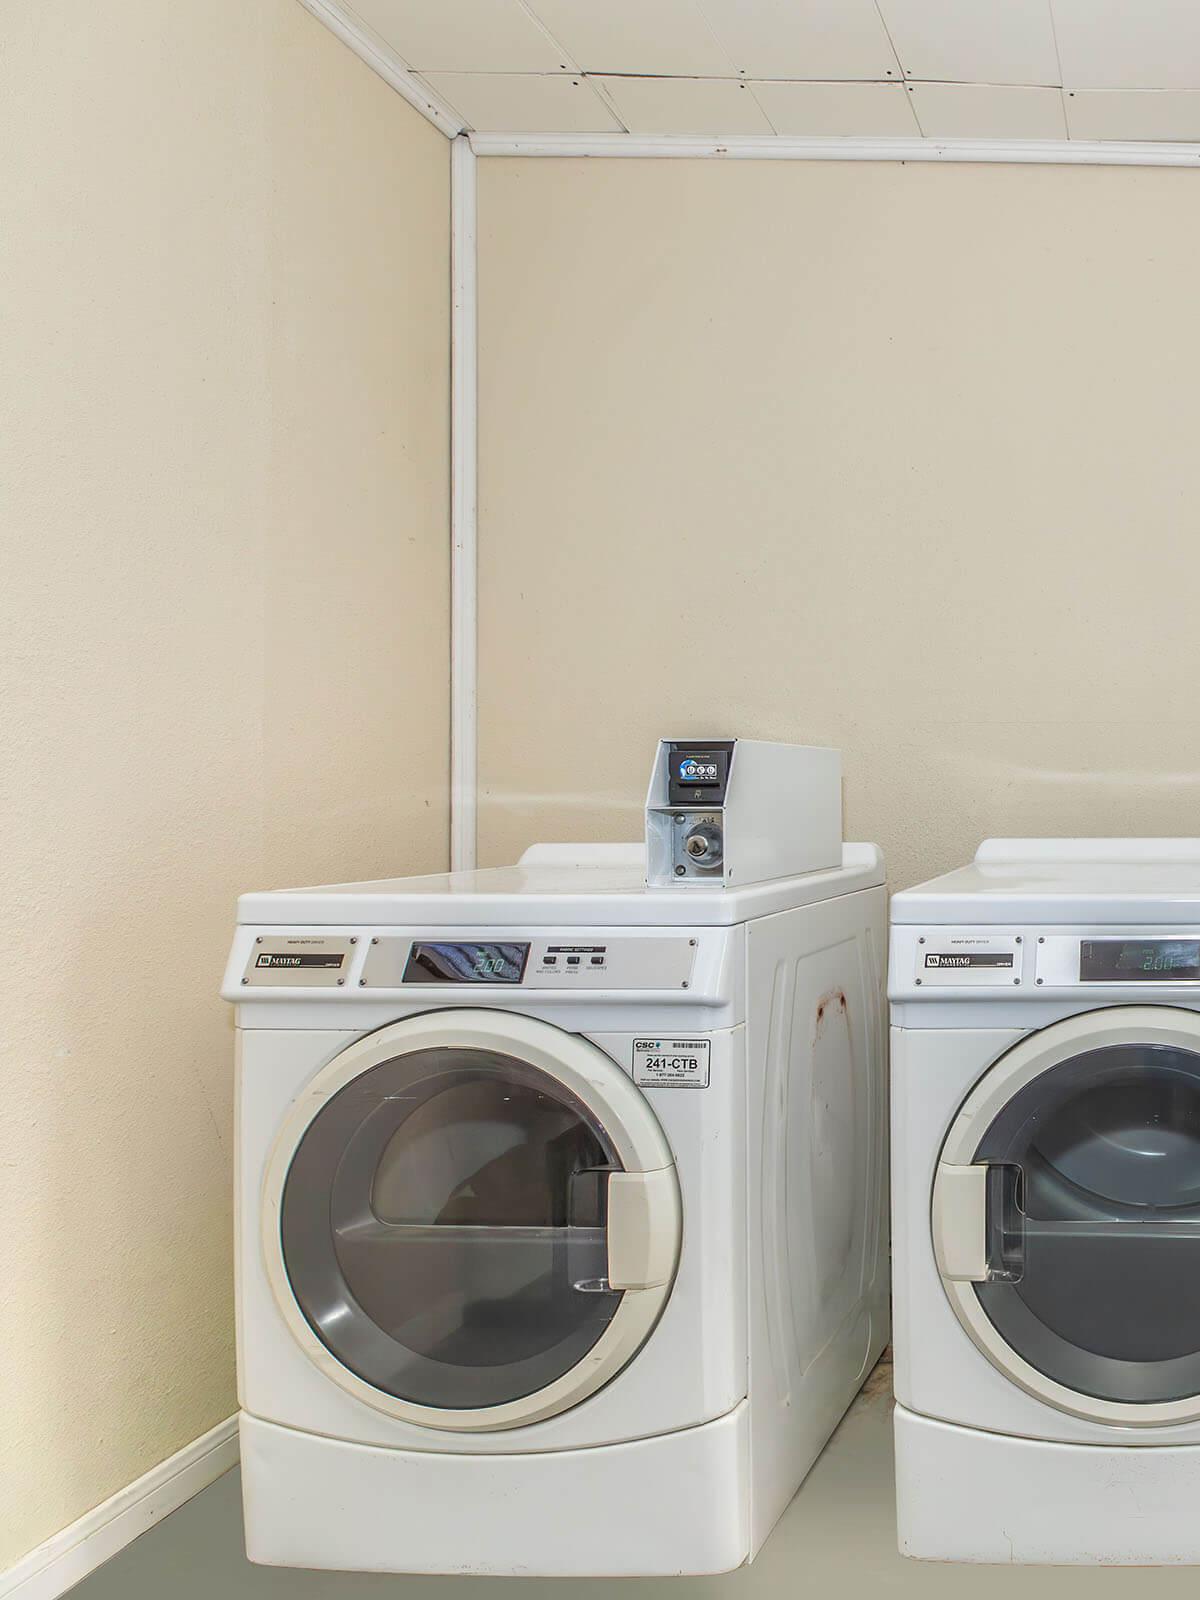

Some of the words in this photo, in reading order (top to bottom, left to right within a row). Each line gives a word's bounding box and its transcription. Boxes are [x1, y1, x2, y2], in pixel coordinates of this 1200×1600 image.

[270, 957, 302, 965] MAYTAG
[939, 957, 970, 965] MAYTAG
[646, 1058, 698, 1069] 241-CTB
